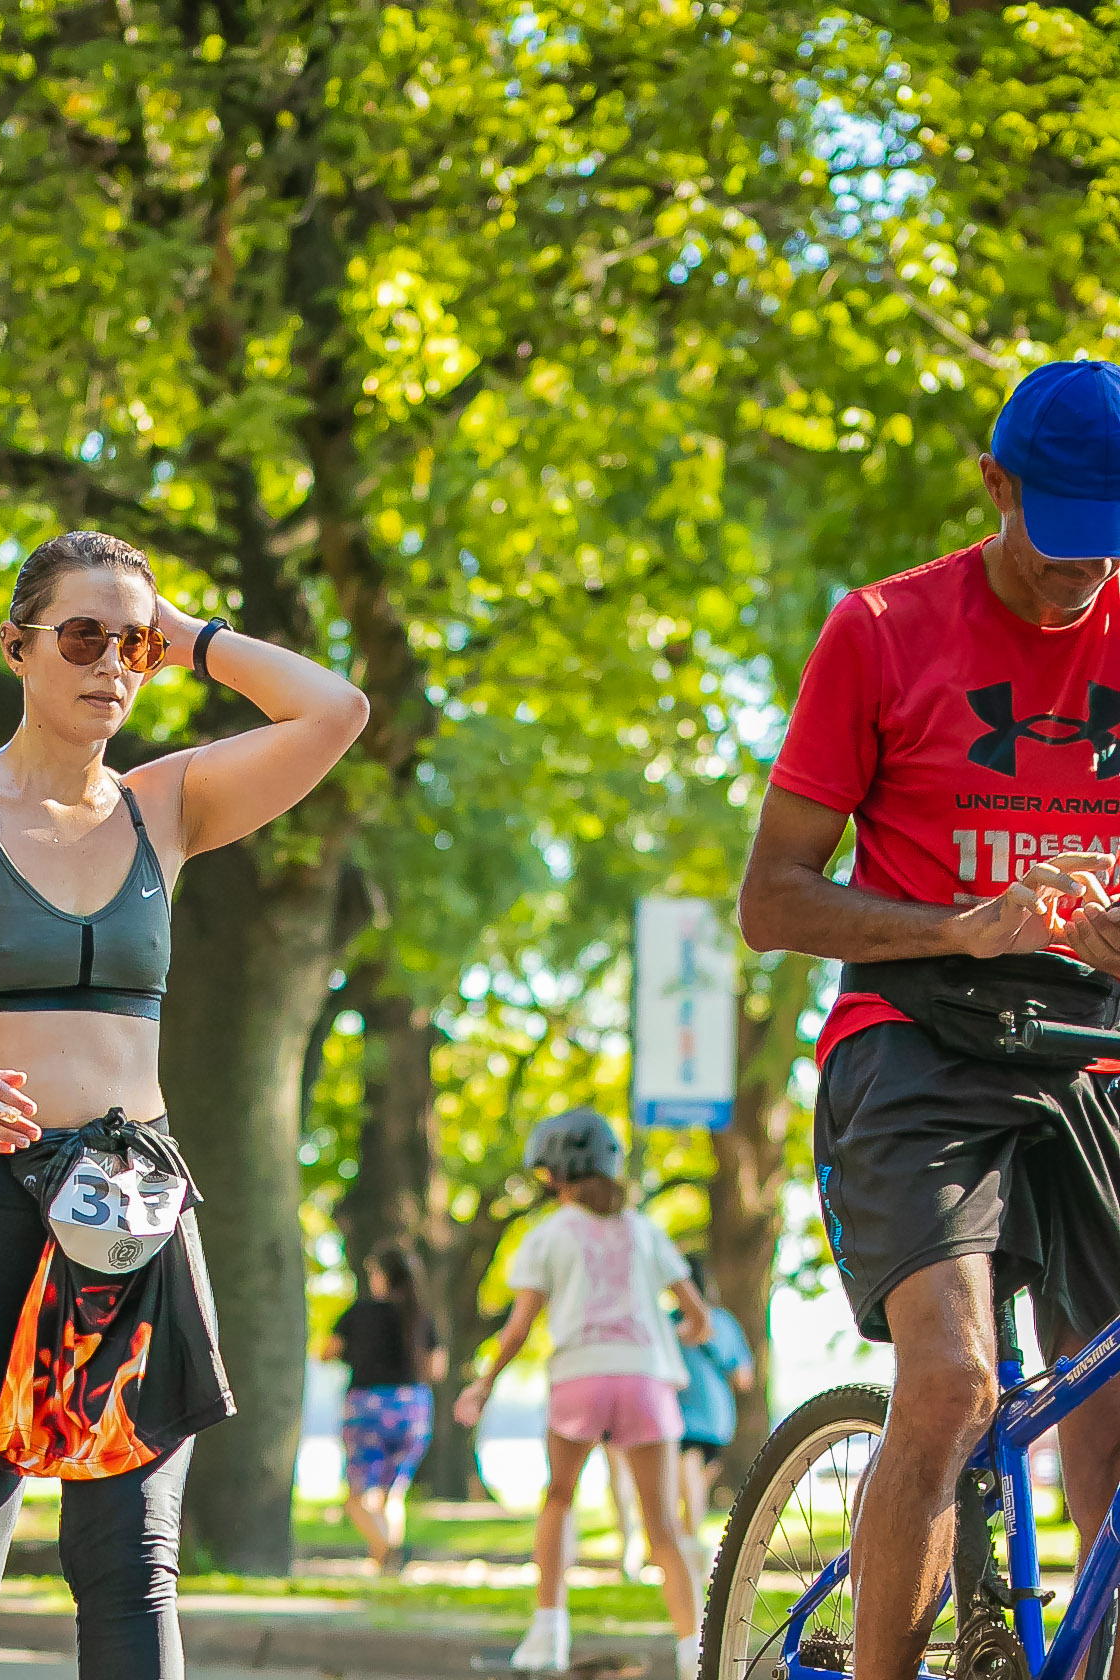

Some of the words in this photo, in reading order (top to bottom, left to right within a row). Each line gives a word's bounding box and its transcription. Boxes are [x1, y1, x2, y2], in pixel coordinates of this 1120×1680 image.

[955, 794, 1043, 813] UNDER
[952, 829, 1011, 883] 11
[118, 1246, 135, 1259] 27
[1065, 1334, 1118, 1386] SUNSHINE
